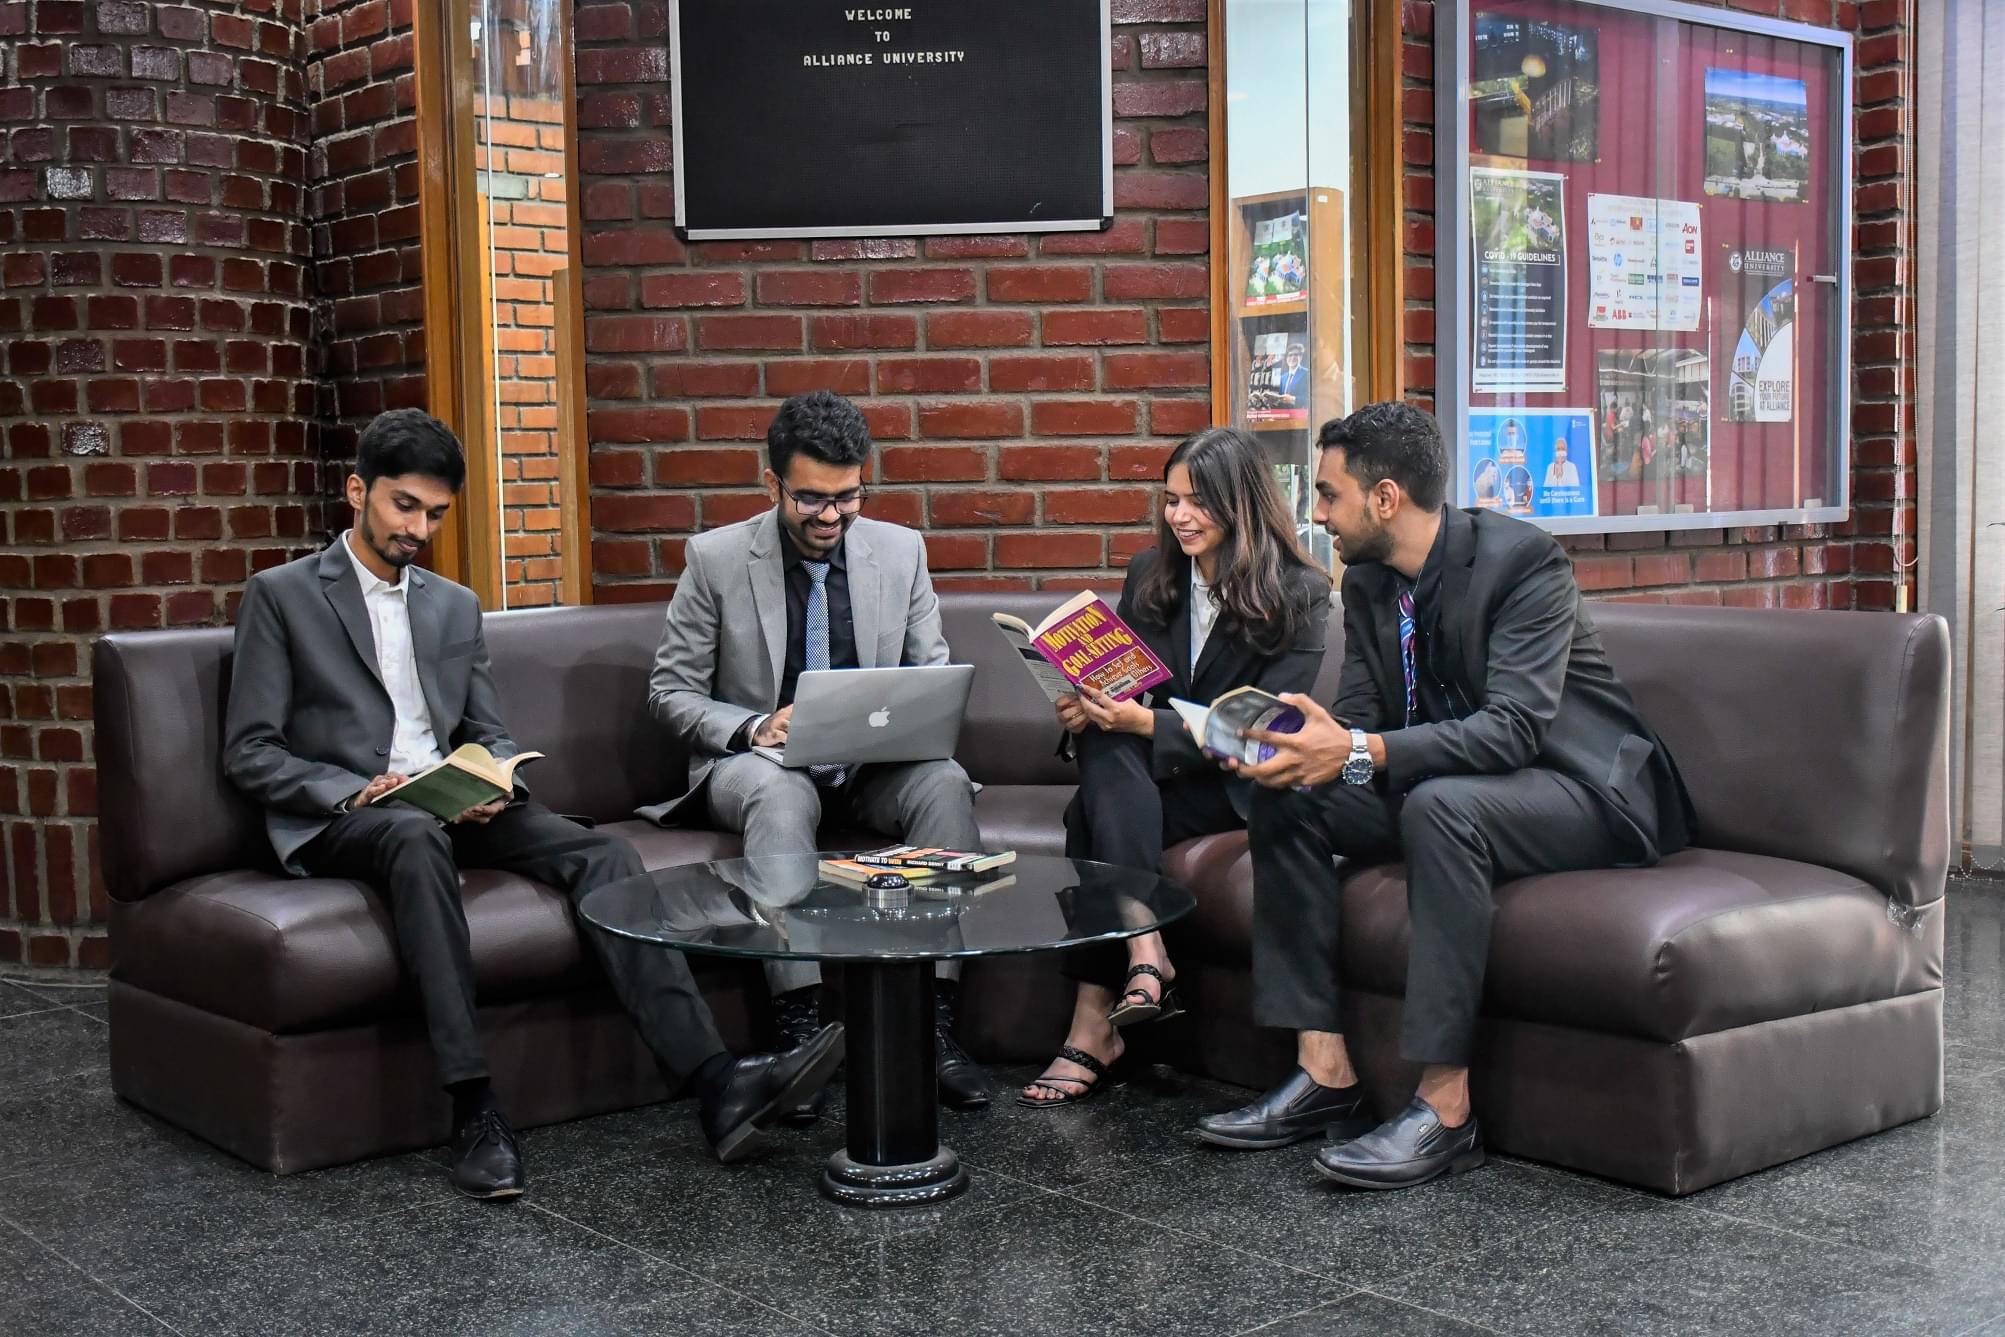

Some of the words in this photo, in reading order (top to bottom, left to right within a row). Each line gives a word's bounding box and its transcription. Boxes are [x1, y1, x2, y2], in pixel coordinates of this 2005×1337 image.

[845, 8, 912, 21] WELCOME
[874, 31, 890, 42] TO
[803, 53, 873, 67] ALLIANCE
[883, 50, 965, 65] UNIVERSITY
[1517, 252, 1556, 263] GUIDELINES
[1744, 250, 1785, 263] ALLIANCE
[1744, 262, 1785, 272] UNIVERSITY
[1612, 309, 1627, 321] ABB
[1759, 380, 1790, 393] EXPLORE
[1759, 401, 1765, 409] AT
[1766, 401, 1790, 410] ALLIANCE
[1041, 606, 1107, 652] MOTIVATION
[1062, 627, 1133, 677] GOAL-SETTING
[1089, 671, 1105, 682] How
[1104, 664, 1113, 675] to
[857, 856, 880, 864] MOTIVATE
